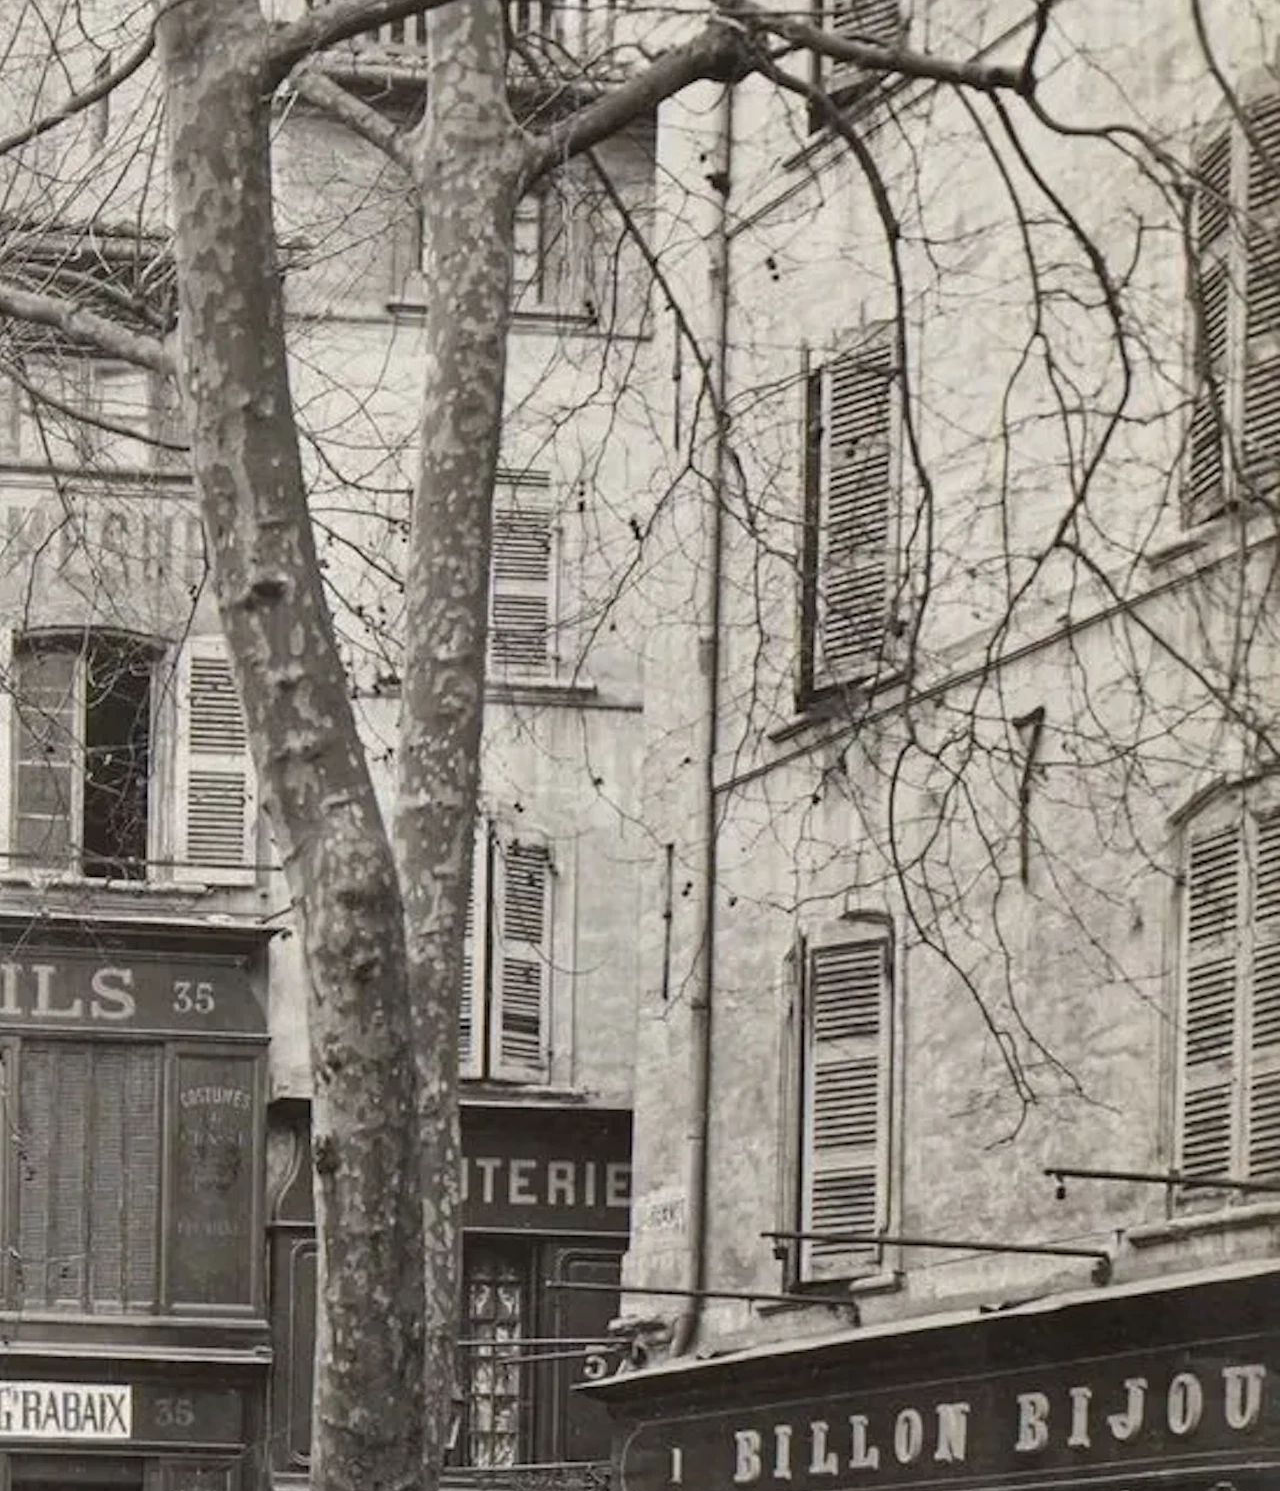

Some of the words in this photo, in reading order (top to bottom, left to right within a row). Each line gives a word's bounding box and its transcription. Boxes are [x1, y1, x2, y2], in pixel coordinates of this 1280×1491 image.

[173, 981, 216, 1015] 35
[22, 1390, 127, 1433] RABAIX
[734, 1402, 971, 1484] BILLON
[1015, 1365, 1266, 1452] BIJOU
